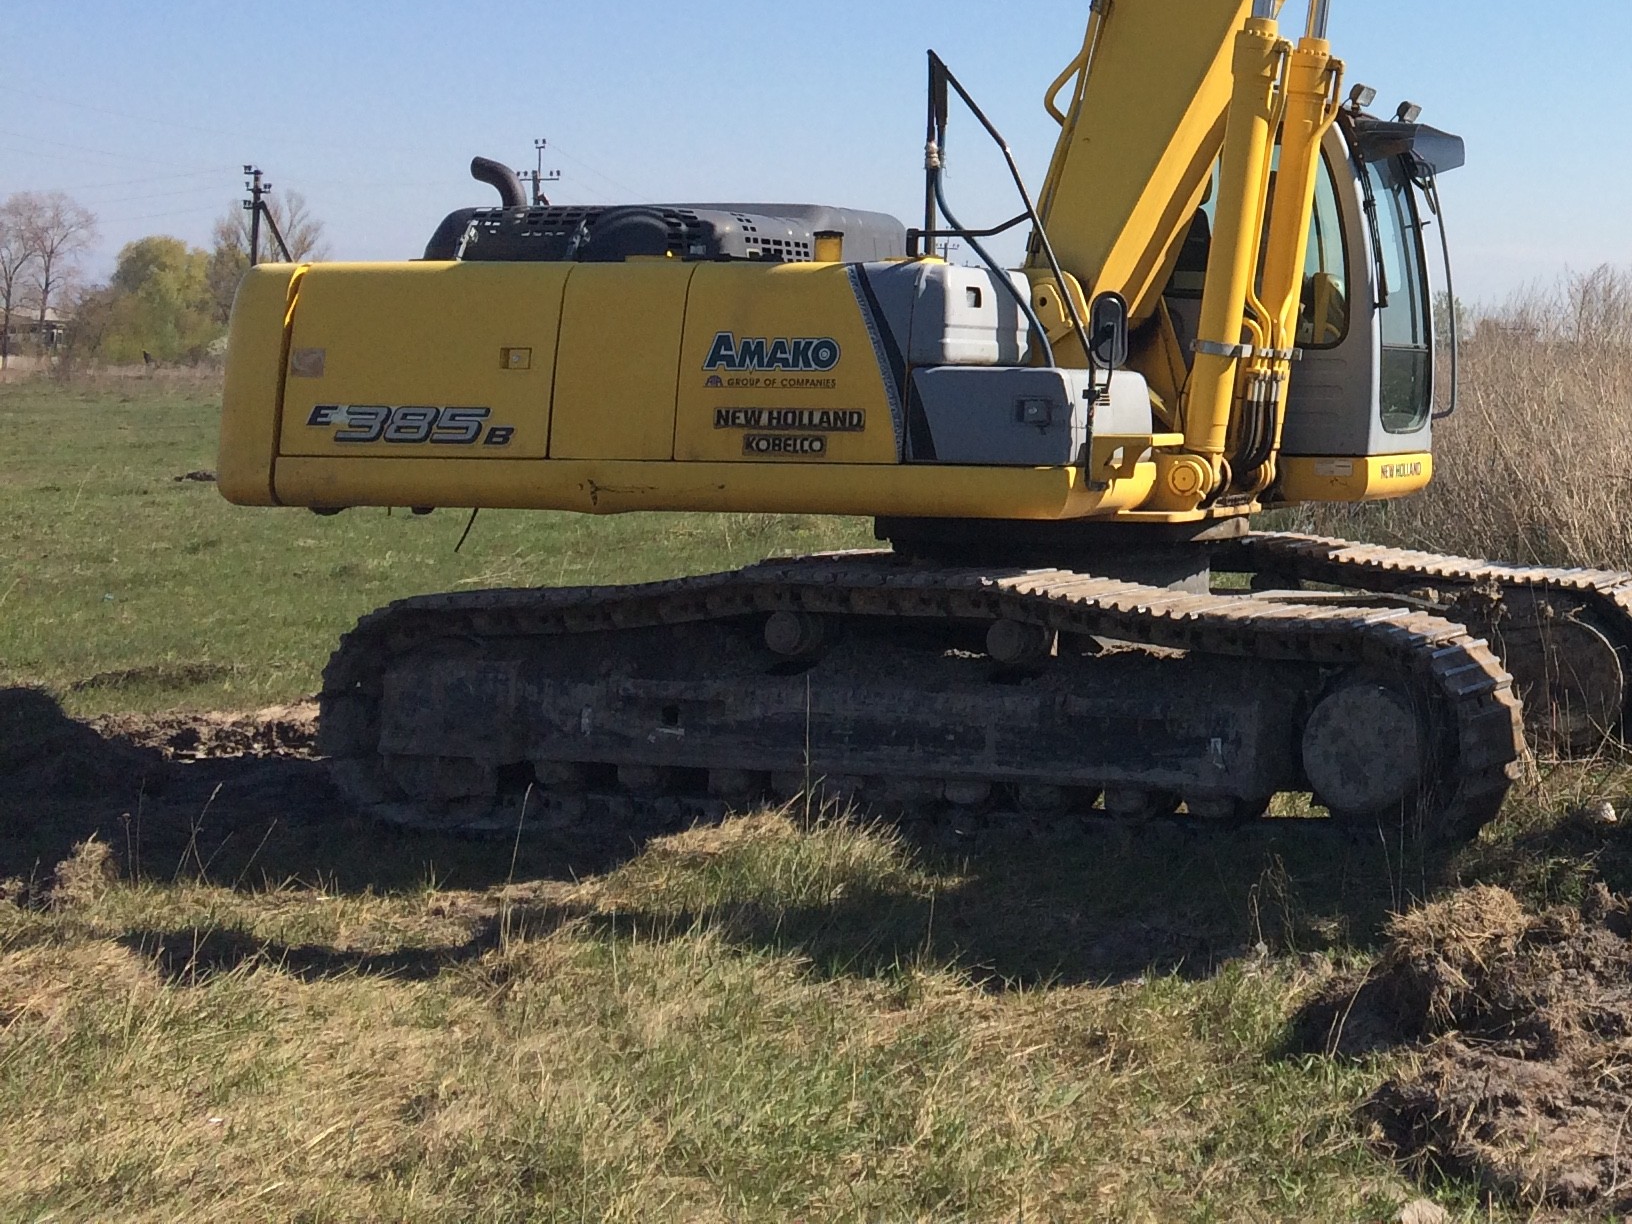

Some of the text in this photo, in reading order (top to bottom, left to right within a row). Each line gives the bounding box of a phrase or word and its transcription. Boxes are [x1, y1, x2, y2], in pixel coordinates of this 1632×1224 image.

[702, 331, 841, 371] AMAKO
[727, 378, 760, 387] GROUP
[764, 378, 776, 387] OF
[780, 378, 836, 388] COMPANIES
[716, 409, 863, 428] NEW HOLLAND
[744, 437, 824, 454] KOBELCO
